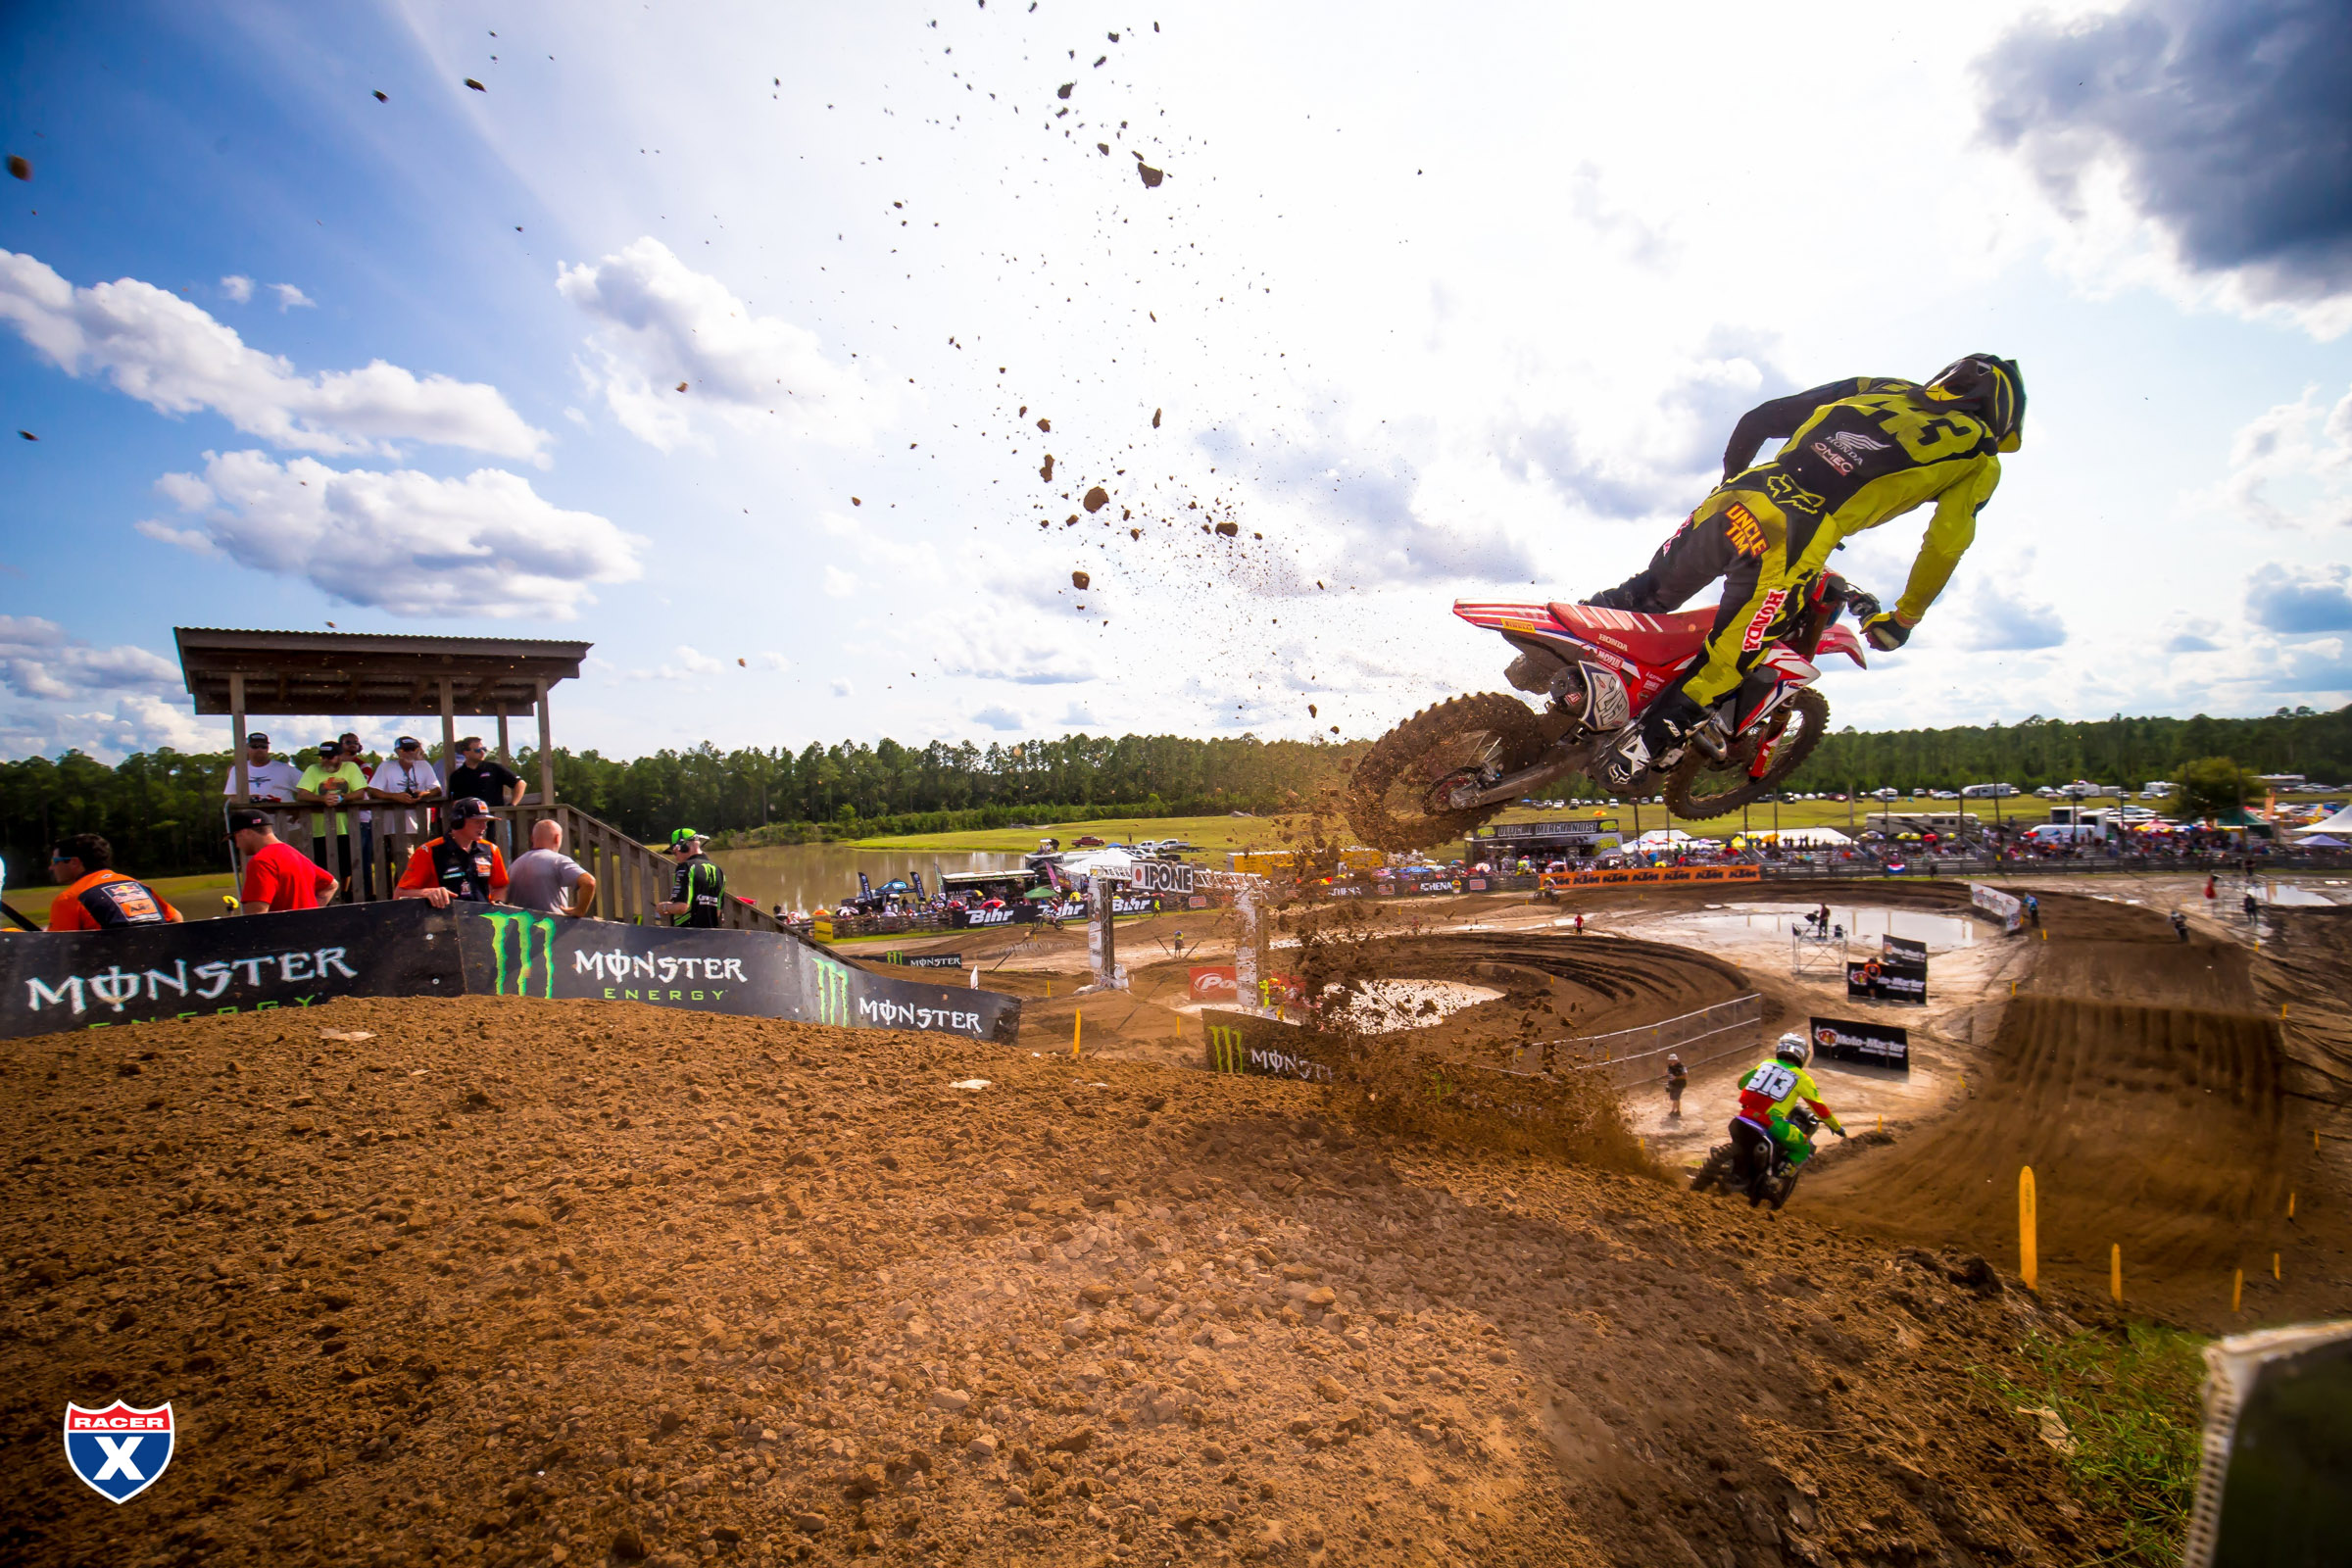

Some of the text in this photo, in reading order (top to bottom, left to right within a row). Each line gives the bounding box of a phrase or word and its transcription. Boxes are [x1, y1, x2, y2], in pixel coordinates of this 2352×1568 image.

[1814, 442, 1854, 472] OMEC
[1826, 435, 1864, 466] HONDA
[1726, 505, 1767, 557] UNCLE
[1726, 521, 1749, 556] TIM
[1743, 590, 1788, 651] HONDA
[1598, 633, 1628, 652] HONDA
[1597, 650, 1622, 668] MOTUL
[1145, 862, 1194, 893] IPONE
[965, 907, 1014, 924] Bihr
[1112, 898, 1152, 912] Bihr
[573, 948, 748, 984] MONSTER
[910, 956, 961, 967] MONSTER
[25, 947, 359, 1015] MONSTER
[604, 988, 724, 1001] ENERGY
[858, 997, 983, 1033] MONSTER
[1745, 1064, 1798, 1102] 913
